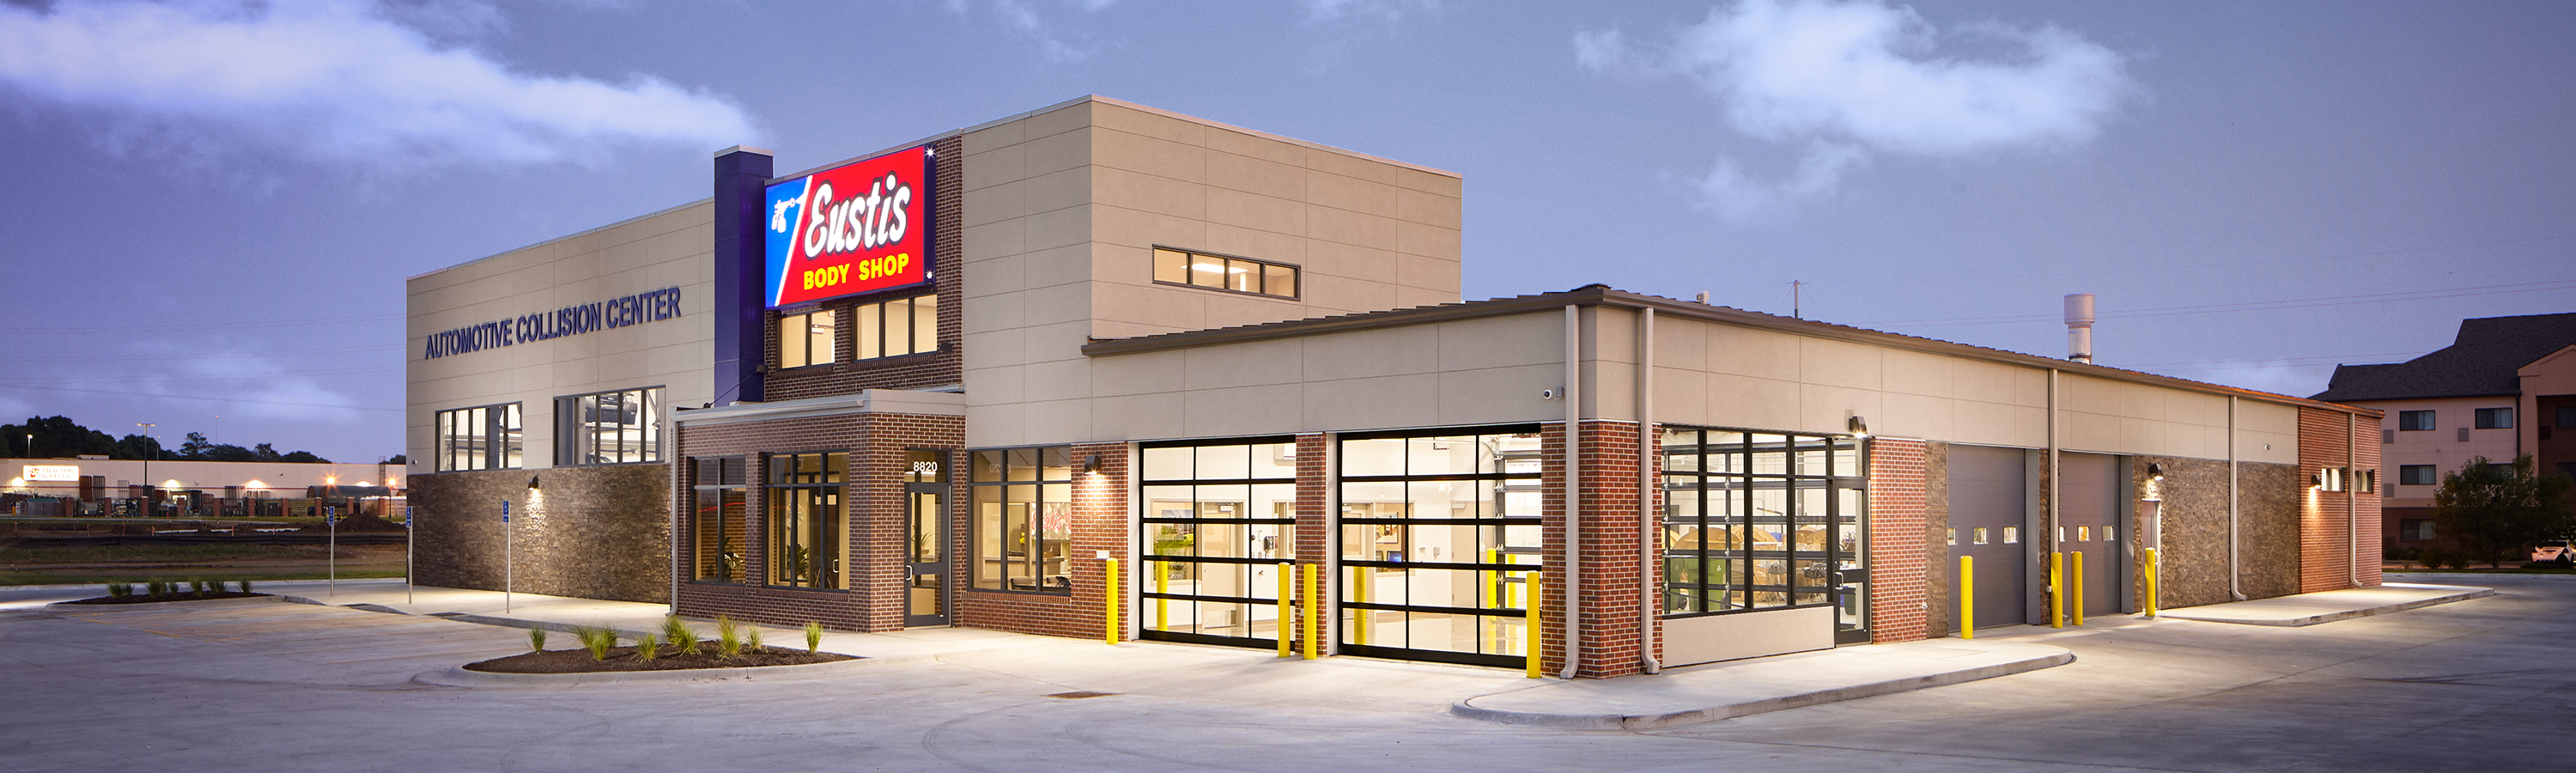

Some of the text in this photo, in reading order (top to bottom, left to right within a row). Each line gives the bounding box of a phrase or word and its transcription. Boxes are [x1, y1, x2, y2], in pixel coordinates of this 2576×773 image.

[804, 171, 912, 260] Eustis
[804, 253, 909, 290] BODY SHOP
[424, 287, 682, 360] AUTOMOTIVE COLLISION CENTER
[913, 461, 938, 472] 8820
